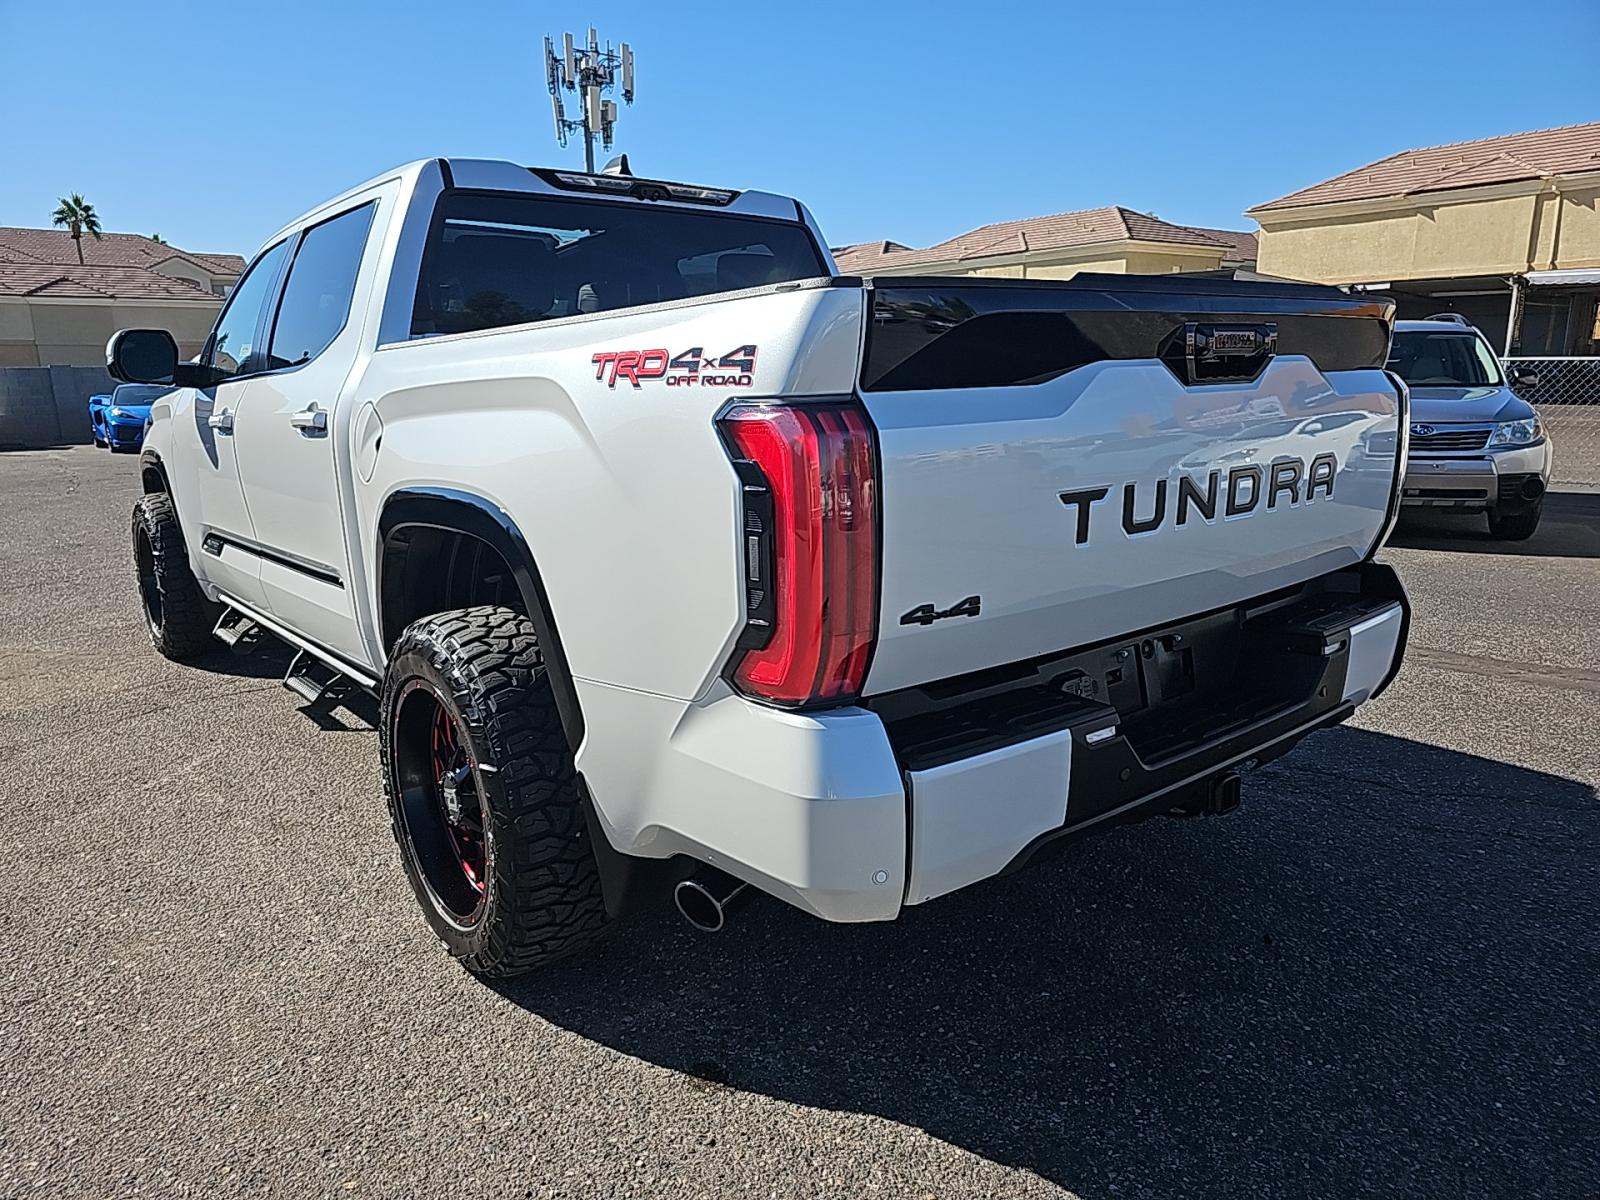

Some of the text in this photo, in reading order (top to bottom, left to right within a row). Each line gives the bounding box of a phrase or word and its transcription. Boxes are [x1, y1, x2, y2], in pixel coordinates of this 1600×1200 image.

[592, 345, 757, 389] TRD 4x4
[666, 375, 753, 387] OFF ROAD
[1058, 452, 1337, 547] TUNDRA
